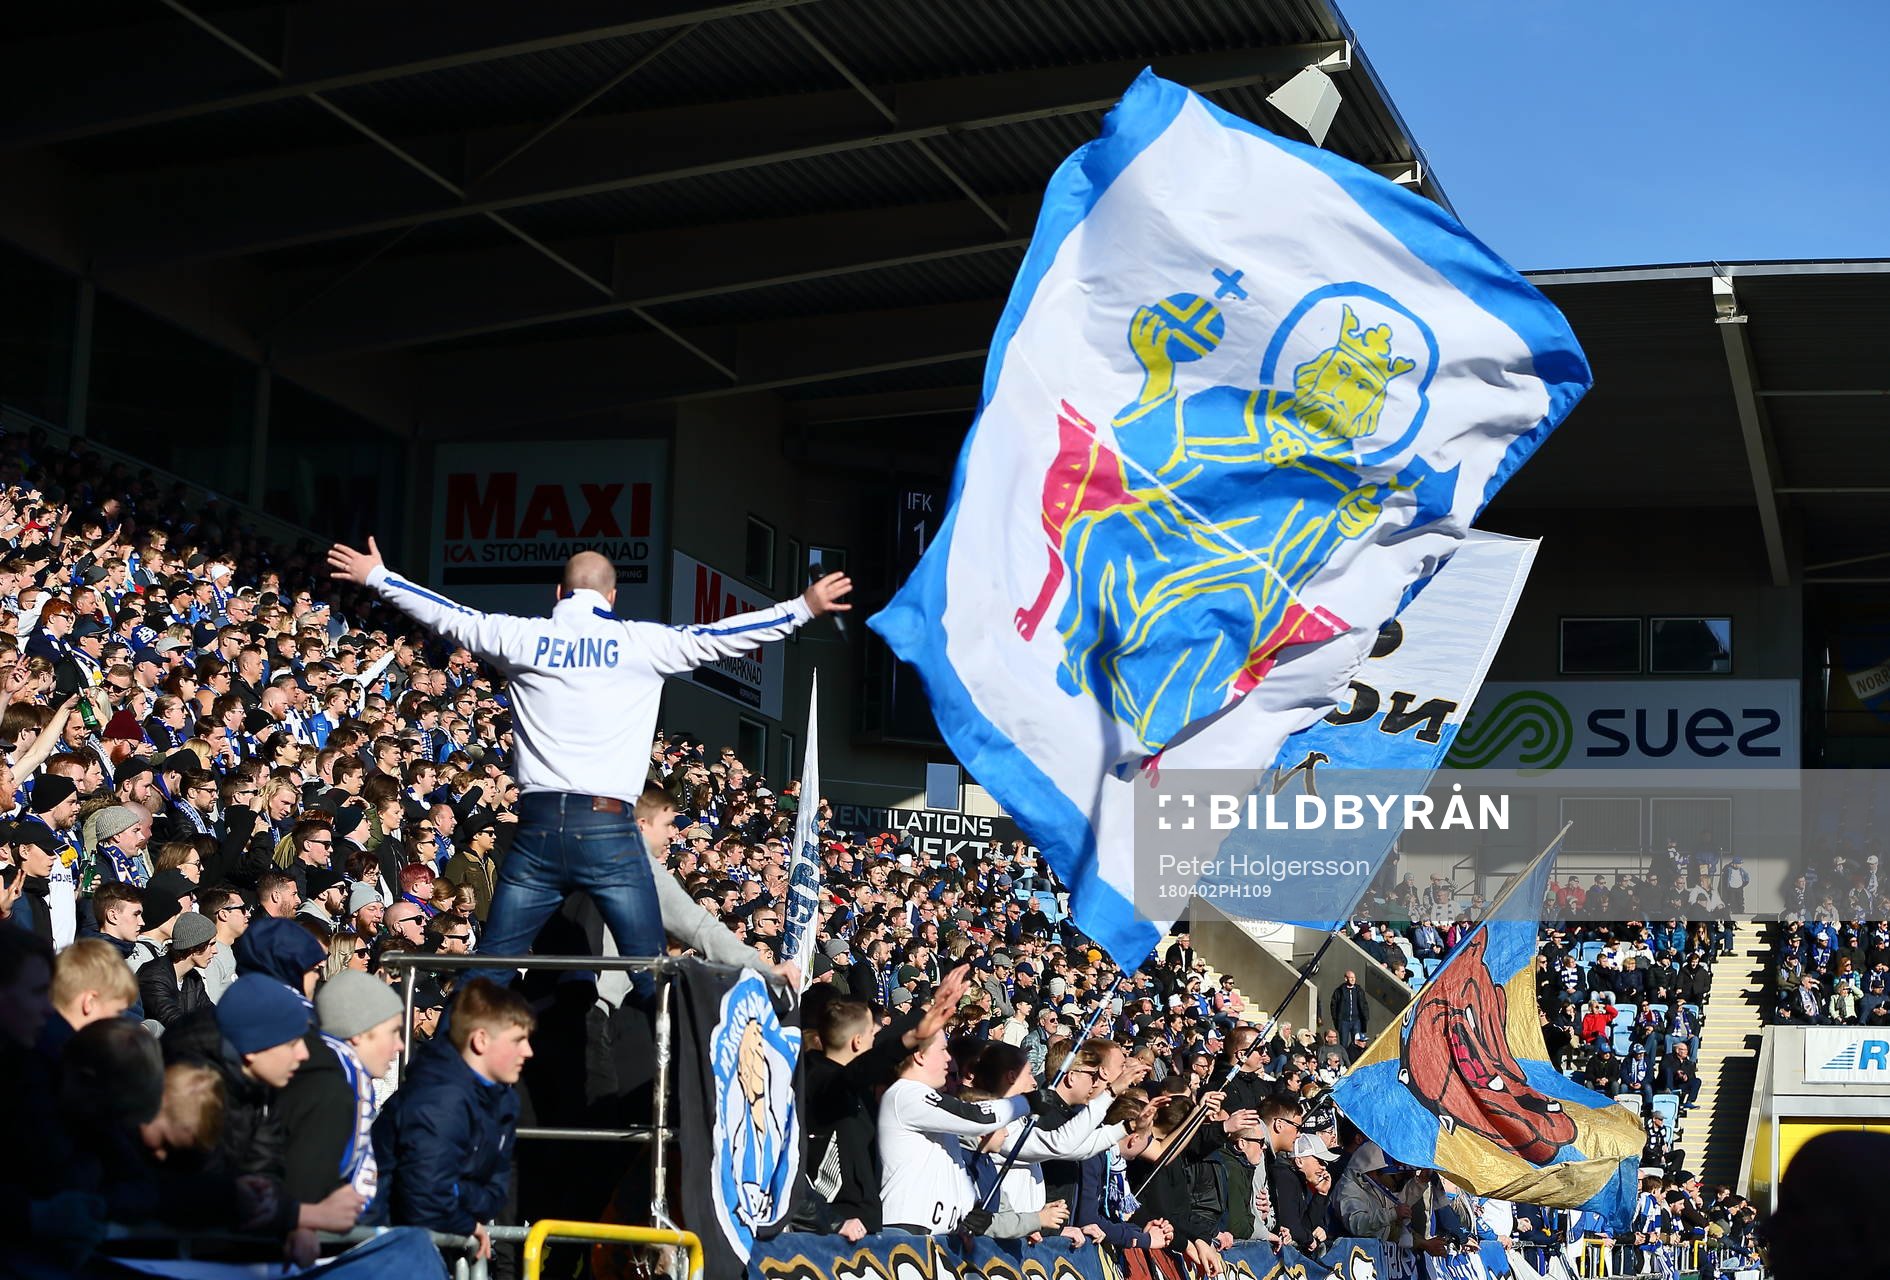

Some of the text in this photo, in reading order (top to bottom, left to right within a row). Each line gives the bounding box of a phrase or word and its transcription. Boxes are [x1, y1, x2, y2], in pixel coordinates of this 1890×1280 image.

[446, 473, 653, 540] MAXI
[907, 491, 933, 512] IFK
[444, 543, 478, 562] ICA
[533, 636, 619, 668] PEKING
